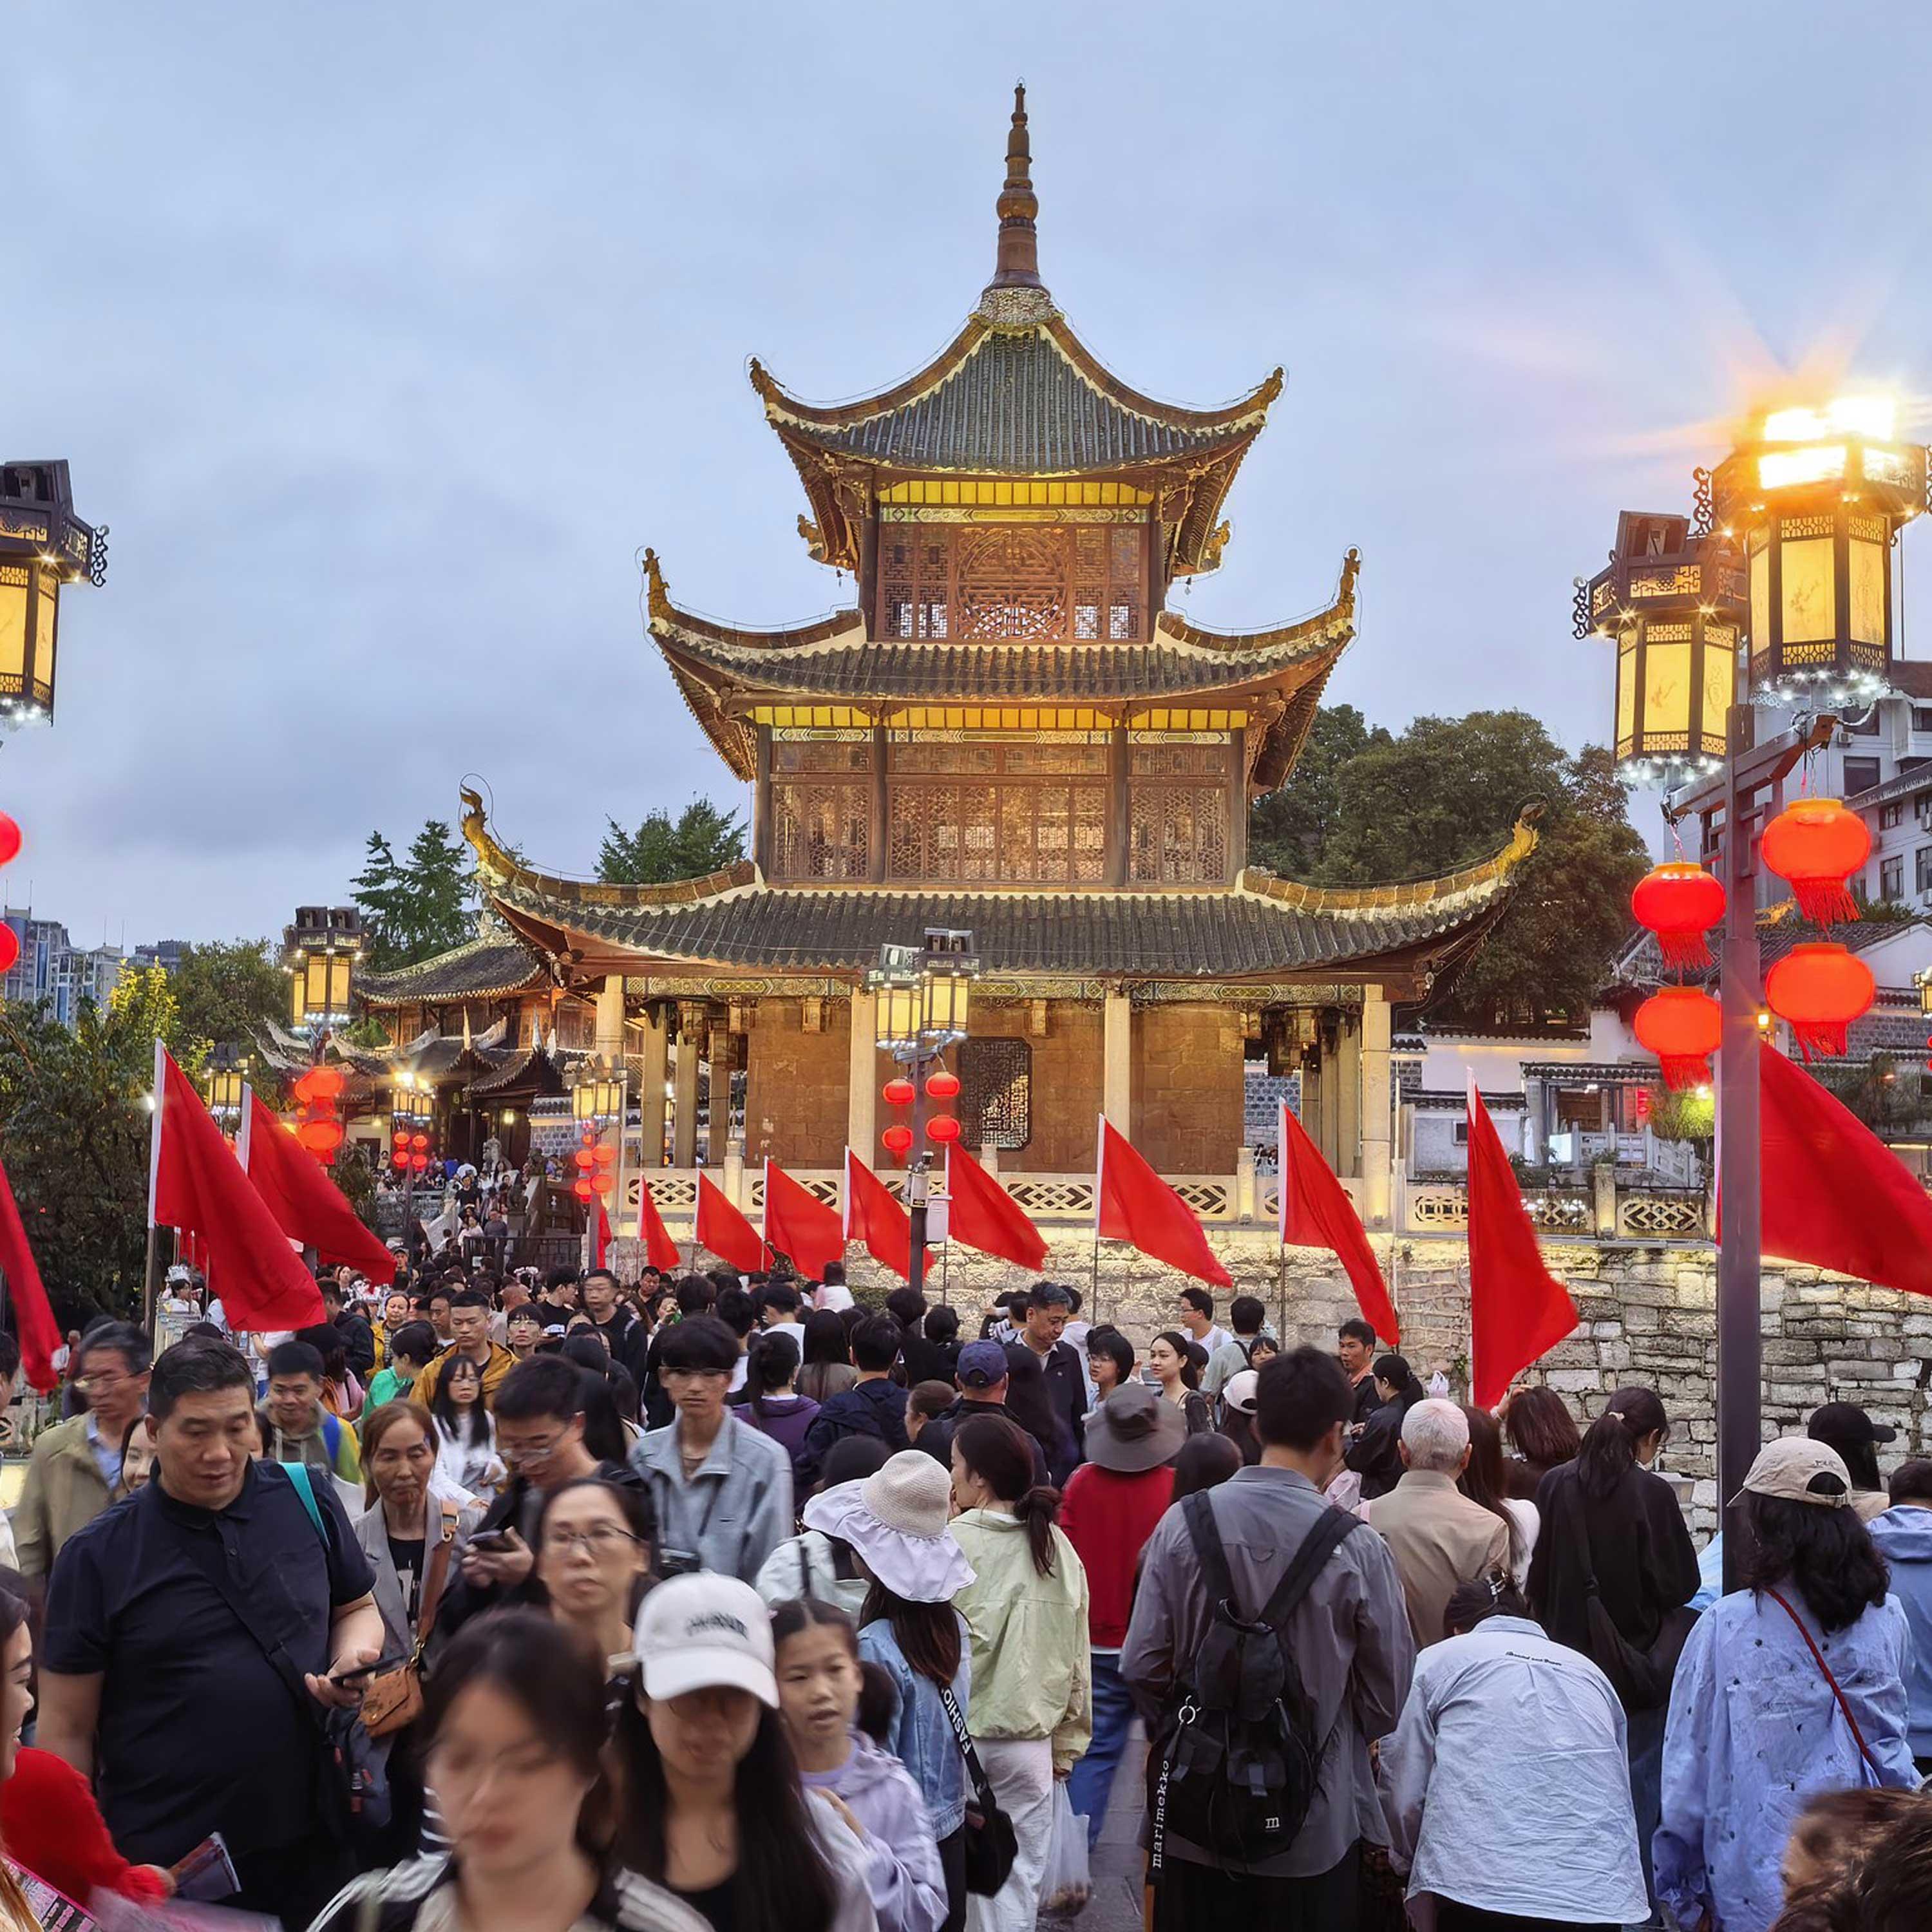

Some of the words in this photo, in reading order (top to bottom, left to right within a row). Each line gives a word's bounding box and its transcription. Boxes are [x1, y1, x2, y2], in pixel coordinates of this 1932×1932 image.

[942, 1689, 972, 1754] FASHIO
[1152, 1760, 1170, 1869] marimekko
[1265, 1817, 1280, 1829] m
